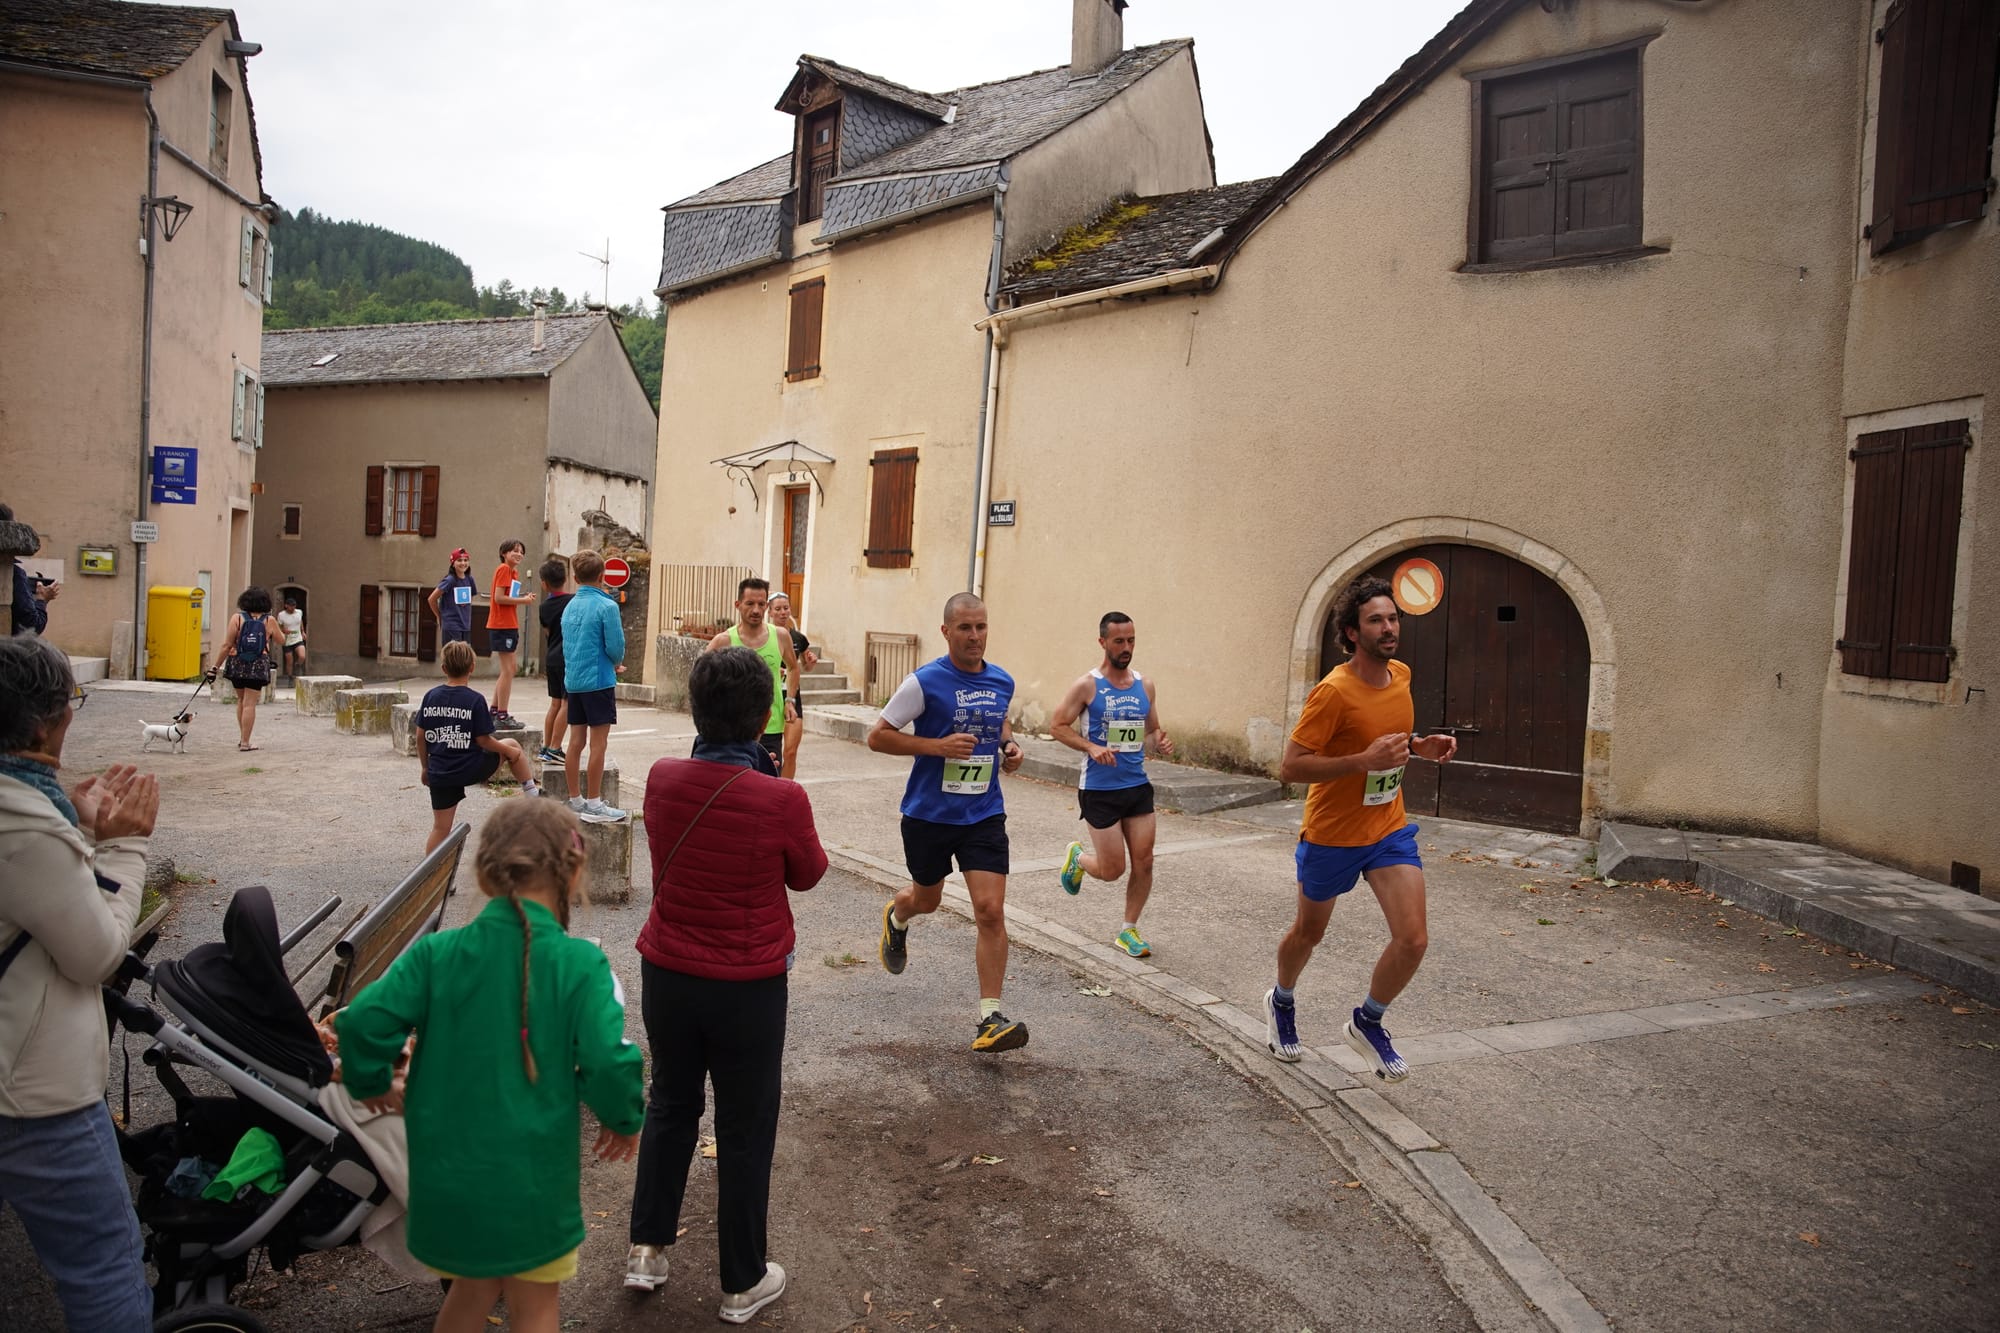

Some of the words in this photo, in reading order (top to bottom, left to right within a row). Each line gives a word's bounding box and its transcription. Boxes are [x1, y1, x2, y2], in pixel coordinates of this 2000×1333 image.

[993, 504, 1010, 513] PLACE
[423, 705, 472, 720] ORGANISATION
[1119, 729, 1136, 742] 70
[959, 765, 982, 781] 77
